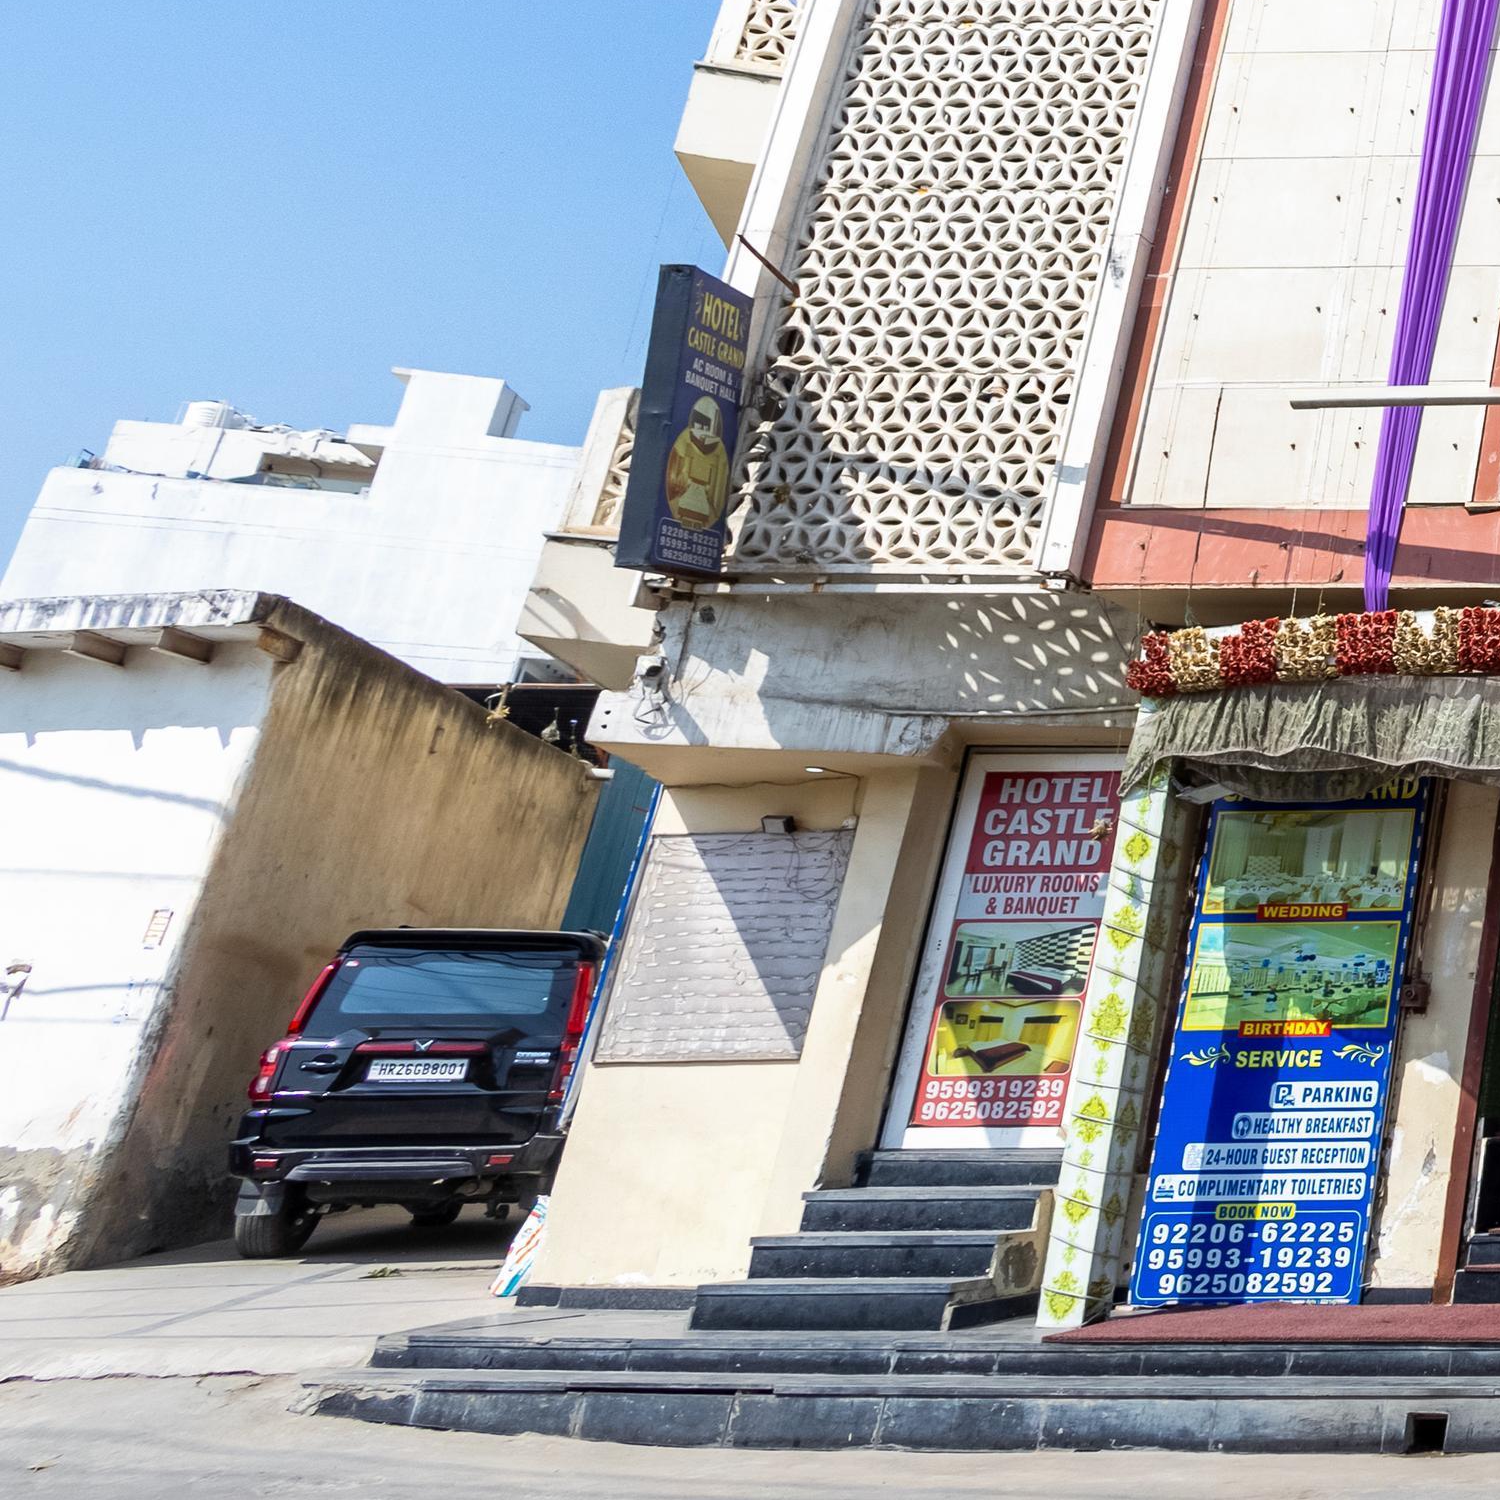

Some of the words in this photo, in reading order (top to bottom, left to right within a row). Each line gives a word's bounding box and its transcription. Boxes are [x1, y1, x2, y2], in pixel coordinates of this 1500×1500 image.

[701, 292, 740, 340] HOTEL
[688, 326, 716, 357] CASTLE
[717, 341, 746, 370] GRAND
[692, 358, 704, 372] AC
[704, 362, 726, 382] ROOM
[685, 370, 718, 395] BANQUET
[719, 383, 736, 403] HALL
[1000, 778, 1110, 804] HOTEL
[983, 808, 1114, 835] CASTLE
[982, 840, 1102, 867] GRAND
[972, 875, 1035, 894] LUXURY
[1039, 874, 1100, 894] ROOMS
[985, 897, 998, 915] &
[1003, 896, 1080, 916] BANQUET
[1263, 905, 1343, 918] WEDDING
[1243, 1022, 1328, 1036] BIRTHDAY
[1235, 1050, 1323, 1067] SERVICE
[378, 1062, 465, 1076] HR26GB8001
[925, 1079, 1064, 1099] 9599319239
[1302, 1086, 1373, 1103] PARKING
[921, 1101, 1061, 1120] 9625082592
[1252, 1118, 1303, 1134] HEALTHY
[1304, 1117, 1371, 1134] BREAKFAST
[1206, 1149, 1258, 1166] 24-HOUR
[1262, 1149, 1297, 1165] GUEST
[1301, 1148, 1366, 1164] RECEPTION
[1178, 1179, 1287, 1196] COMPLIMENTARY
[1291, 1178, 1362, 1195] TOILETRIES
[1219, 1206, 1257, 1219] BOOK
[1260, 1205, 1293, 1218] NOW
[1152, 1222, 1354, 1244] 92206-62225
[1149, 1247, 1350, 1269] 95993-19239
[1158, 1272, 1333, 1295] 9625082592
